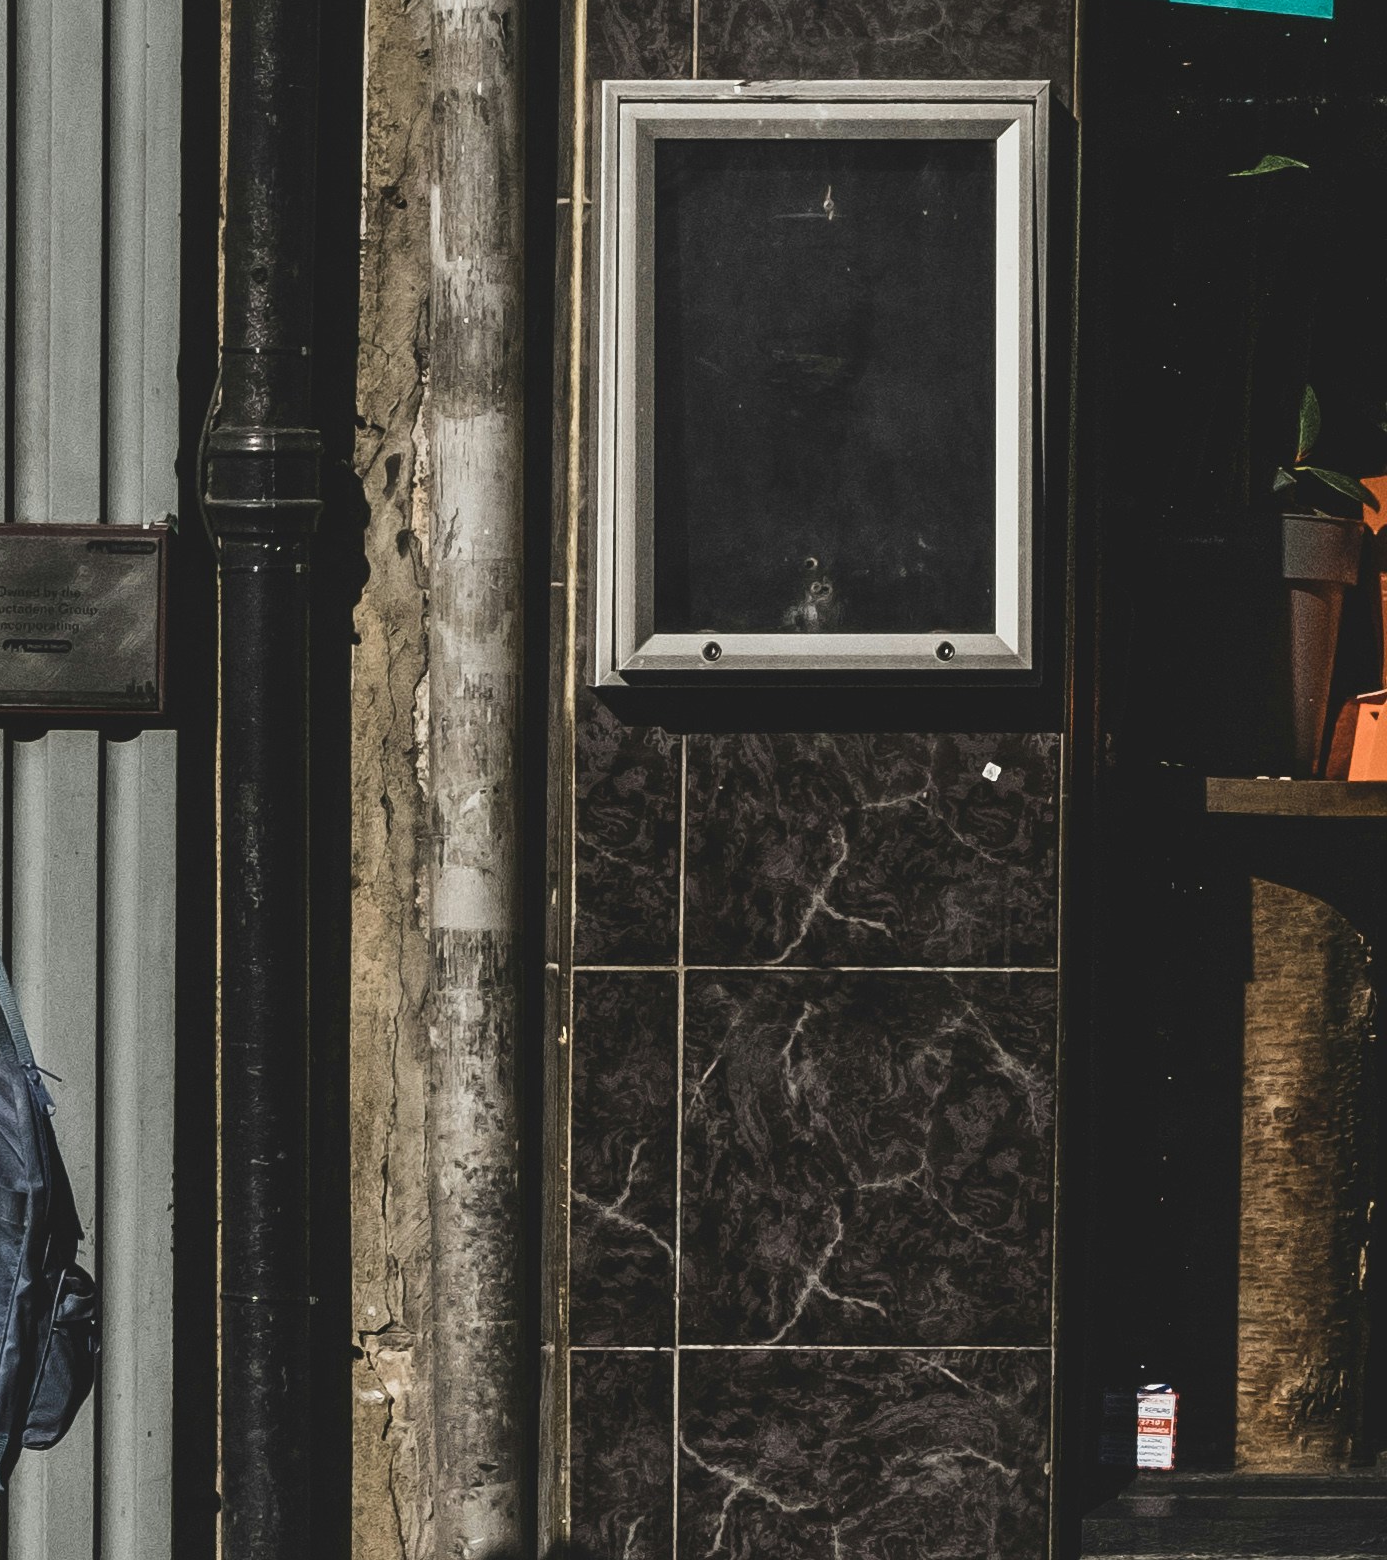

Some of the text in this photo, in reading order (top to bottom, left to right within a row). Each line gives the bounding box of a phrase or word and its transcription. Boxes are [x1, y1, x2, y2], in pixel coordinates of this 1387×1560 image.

[43, 587, 59, 599] by
[61, 586, 82, 598] the
[57, 602, 99, 616] Group
